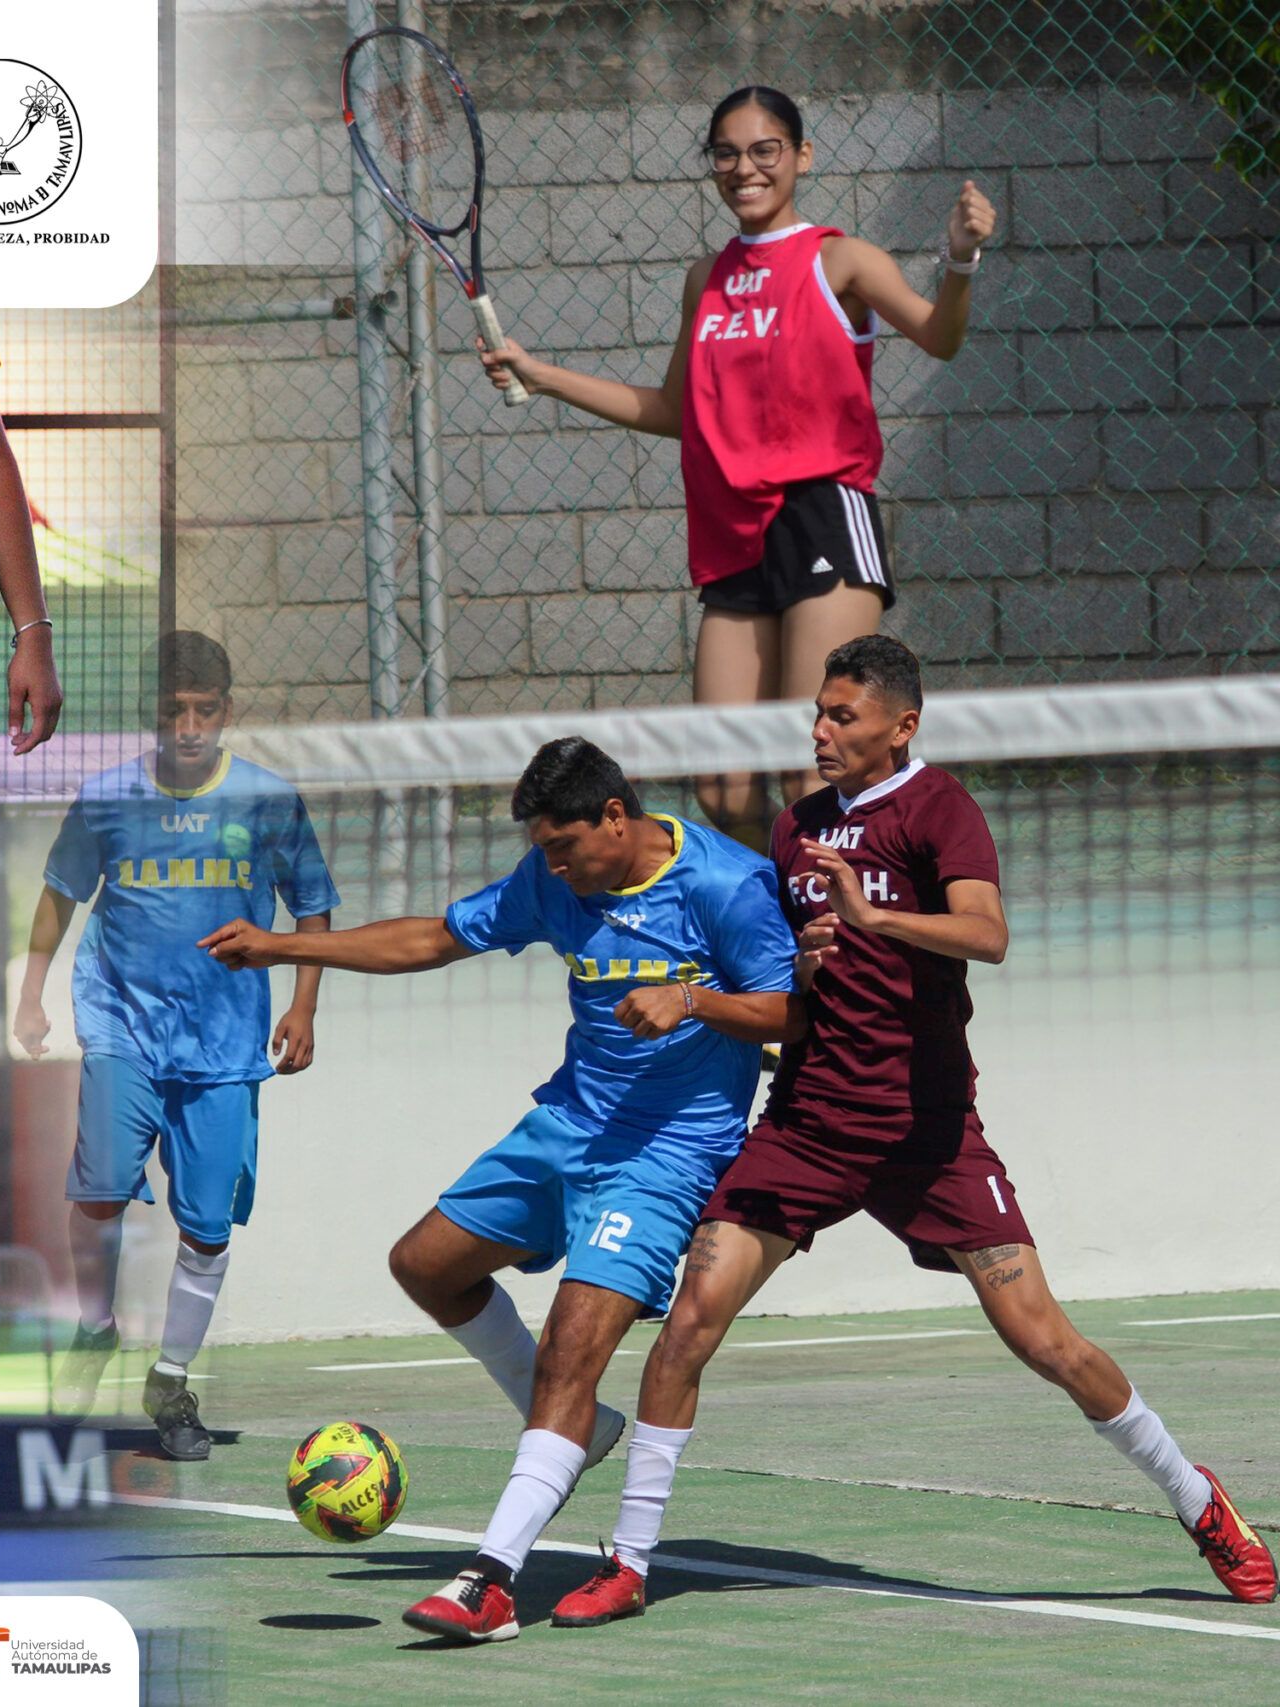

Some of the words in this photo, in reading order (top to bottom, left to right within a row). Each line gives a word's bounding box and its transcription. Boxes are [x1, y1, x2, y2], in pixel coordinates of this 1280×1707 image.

[725, 268, 772, 296] UAT
[698, 307, 780, 342] F.E.V.
[160, 813, 210, 833] UAT
[818, 826, 865, 849] UAT
[986, 1175, 1007, 1214] 1
[588, 1209, 633, 1254] 12
